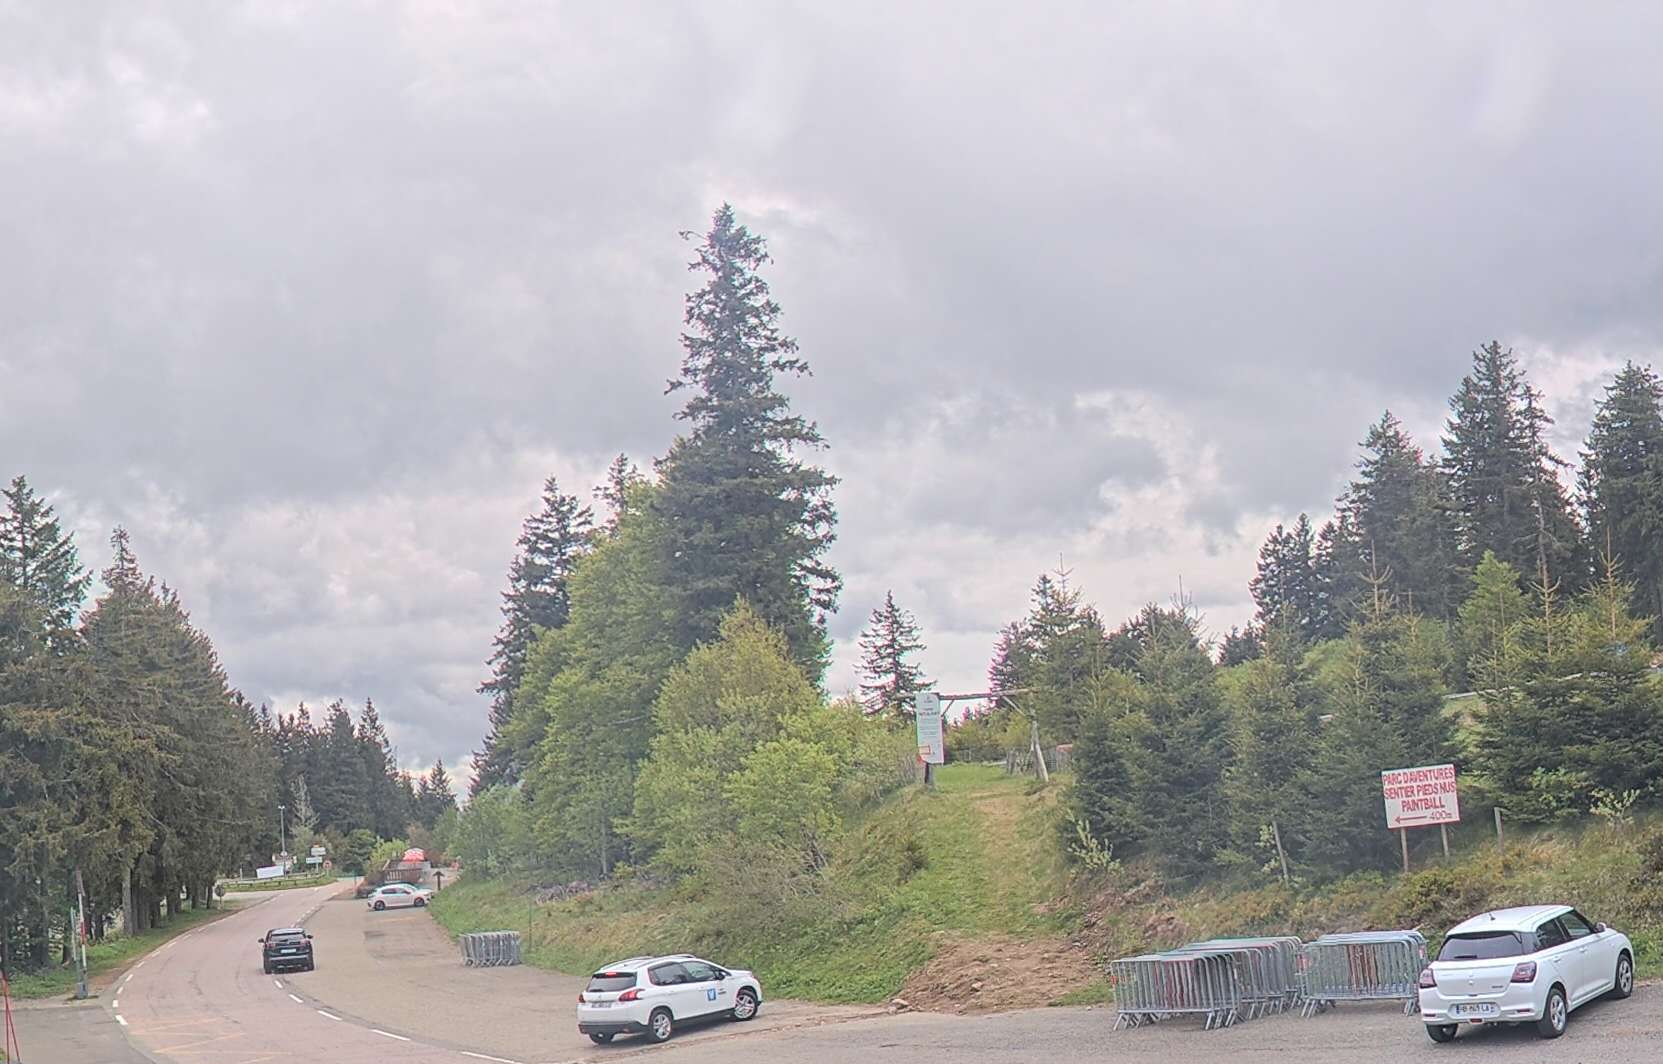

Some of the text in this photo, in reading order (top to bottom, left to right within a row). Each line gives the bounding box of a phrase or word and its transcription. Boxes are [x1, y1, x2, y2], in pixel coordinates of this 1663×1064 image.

[1383, 773, 1402, 785] PARC
[1385, 781, 1456, 799] SENTIER PIEDS NUS
[1401, 797, 1446, 812] PAINTBALL
